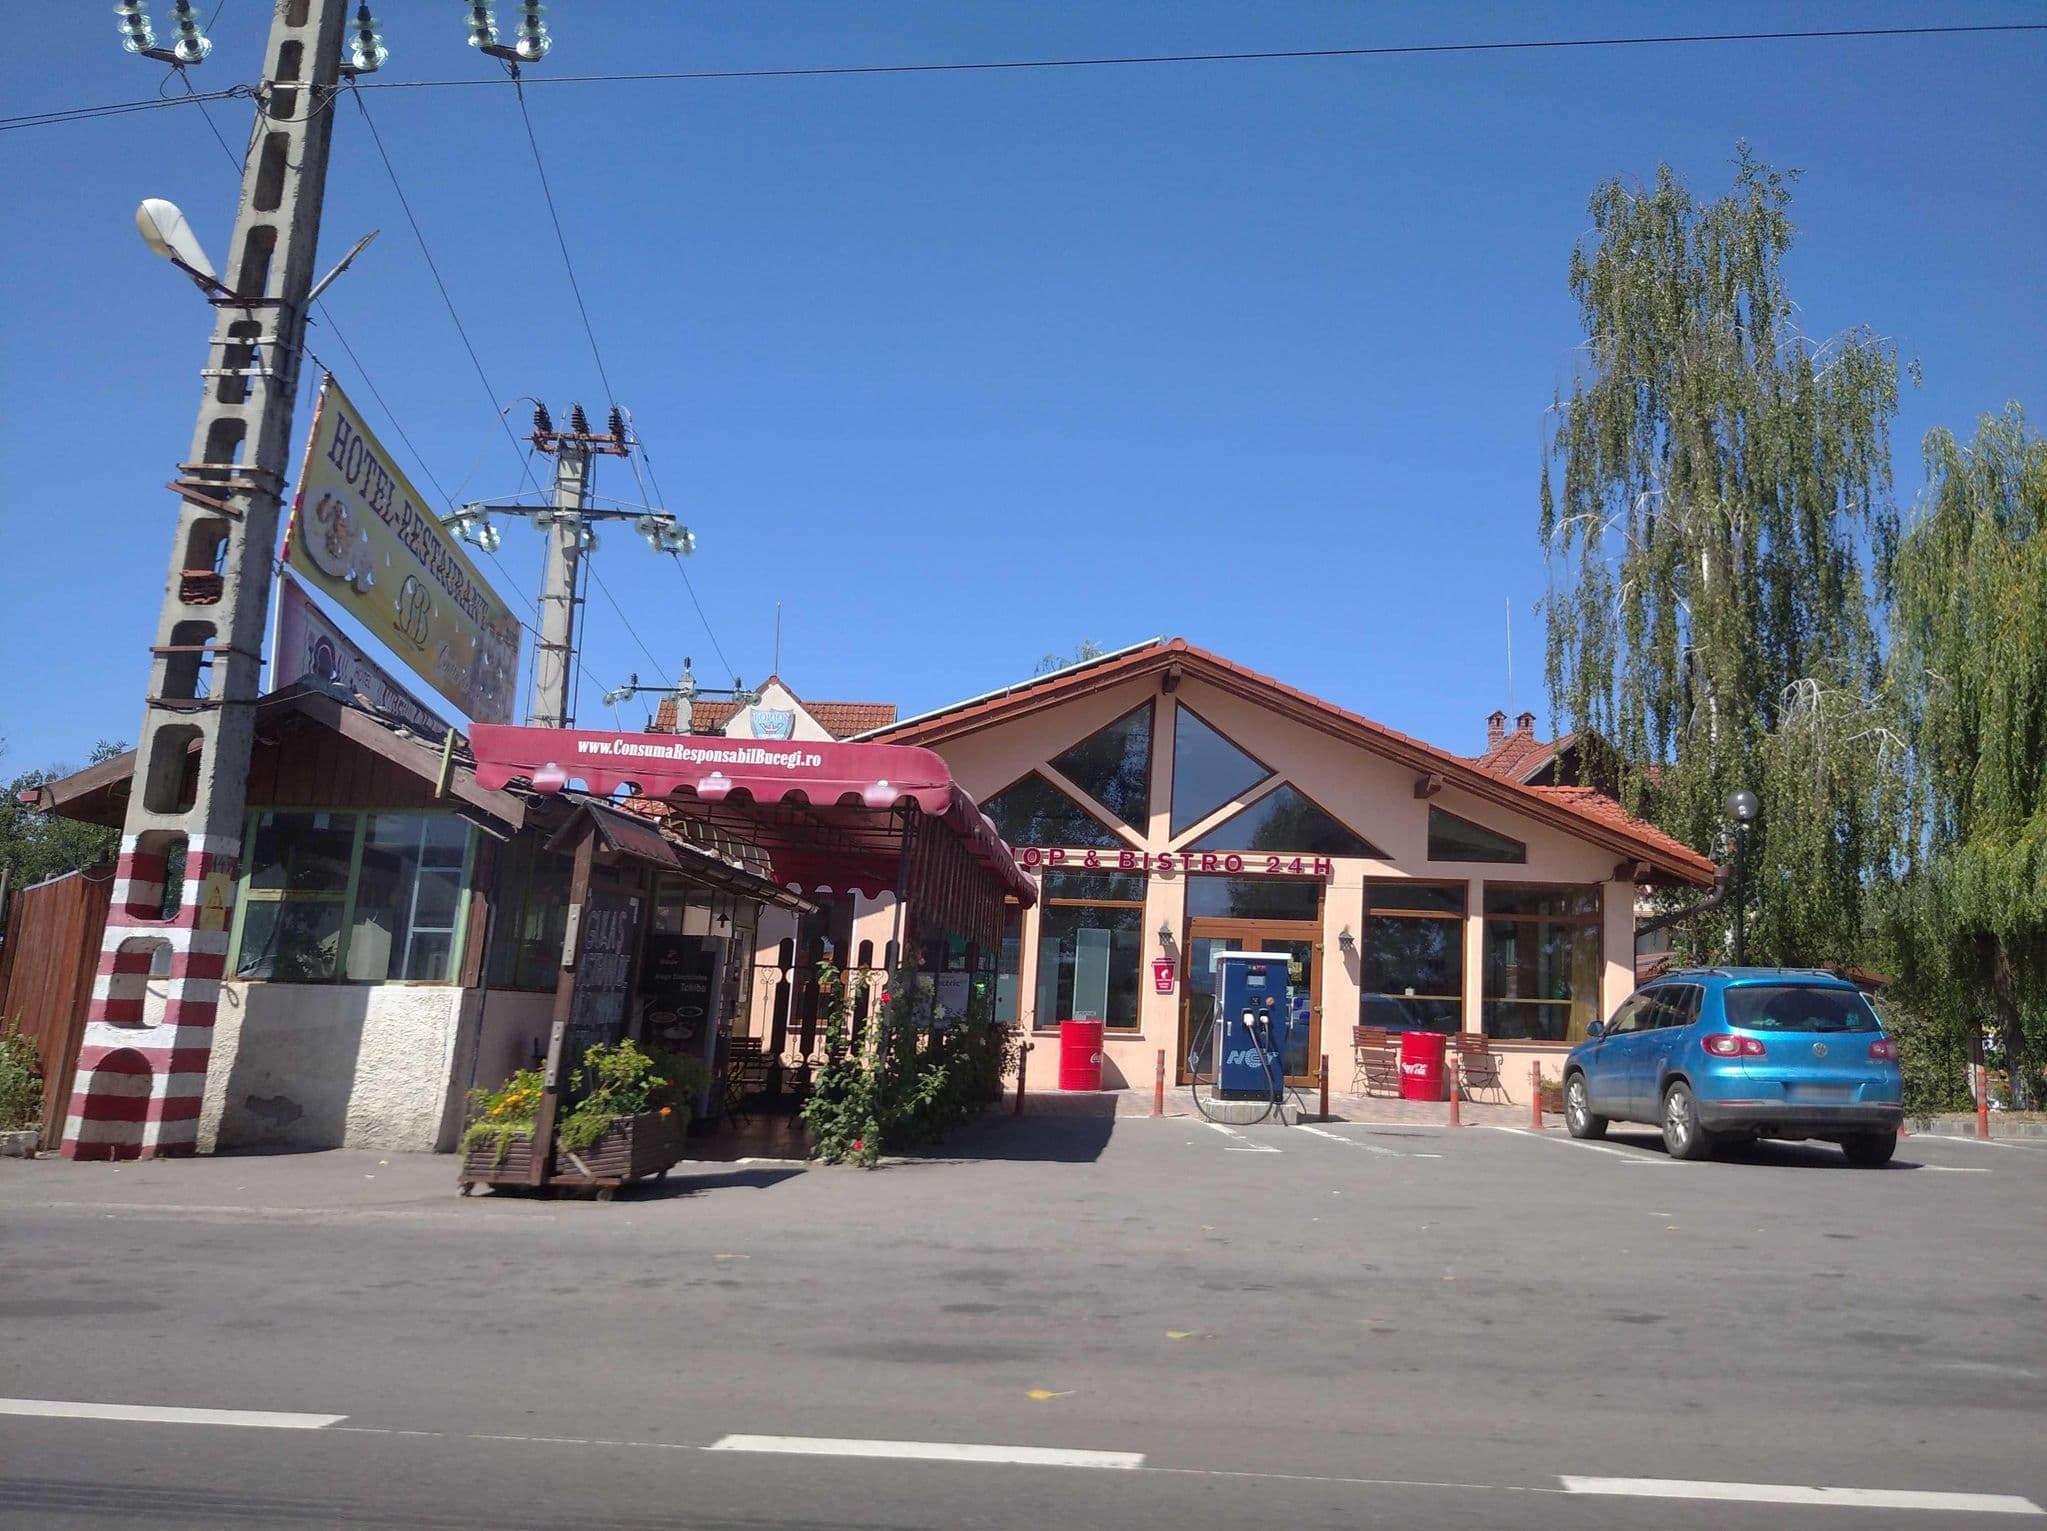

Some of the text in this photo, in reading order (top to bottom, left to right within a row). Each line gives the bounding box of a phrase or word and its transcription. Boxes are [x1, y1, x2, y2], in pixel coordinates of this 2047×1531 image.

[577, 739, 822, 769] www.ConsumaResponsabilBucegi.ro
[1010, 846, 1066, 867] OP
[1083, 849, 1101, 868] &
[1118, 848, 1243, 874] BISTRO
[1266, 855, 1332, 876] 24H
